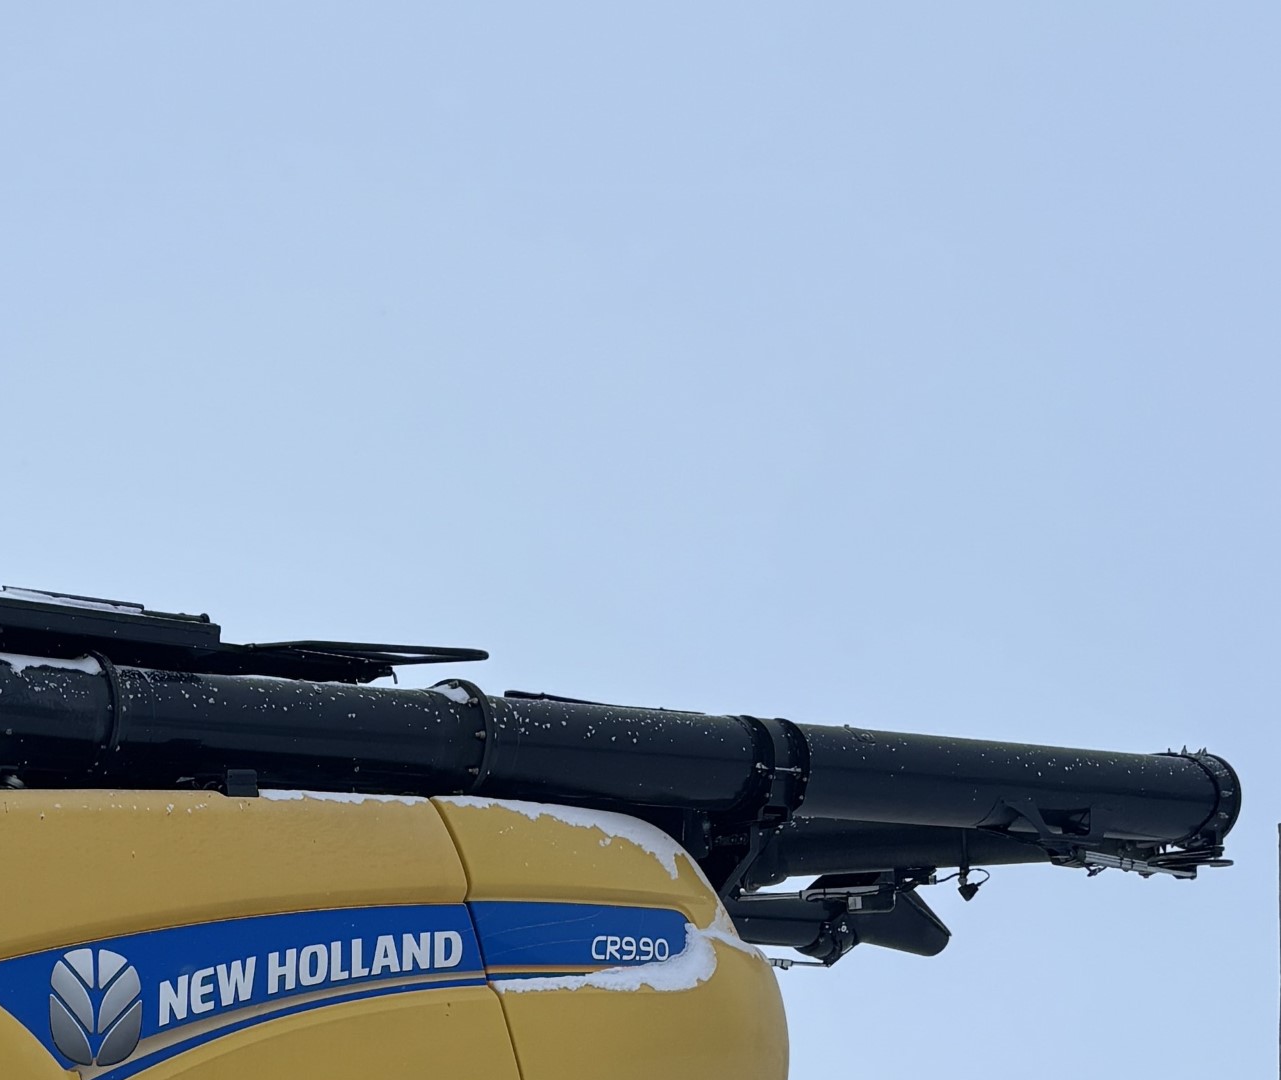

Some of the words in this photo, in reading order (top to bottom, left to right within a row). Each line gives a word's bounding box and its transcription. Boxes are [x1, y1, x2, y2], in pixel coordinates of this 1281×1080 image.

[158, 956, 257, 1027] NEW
[267, 930, 463, 995] HOLLAND
[591, 935, 670, 961] CR9.90
